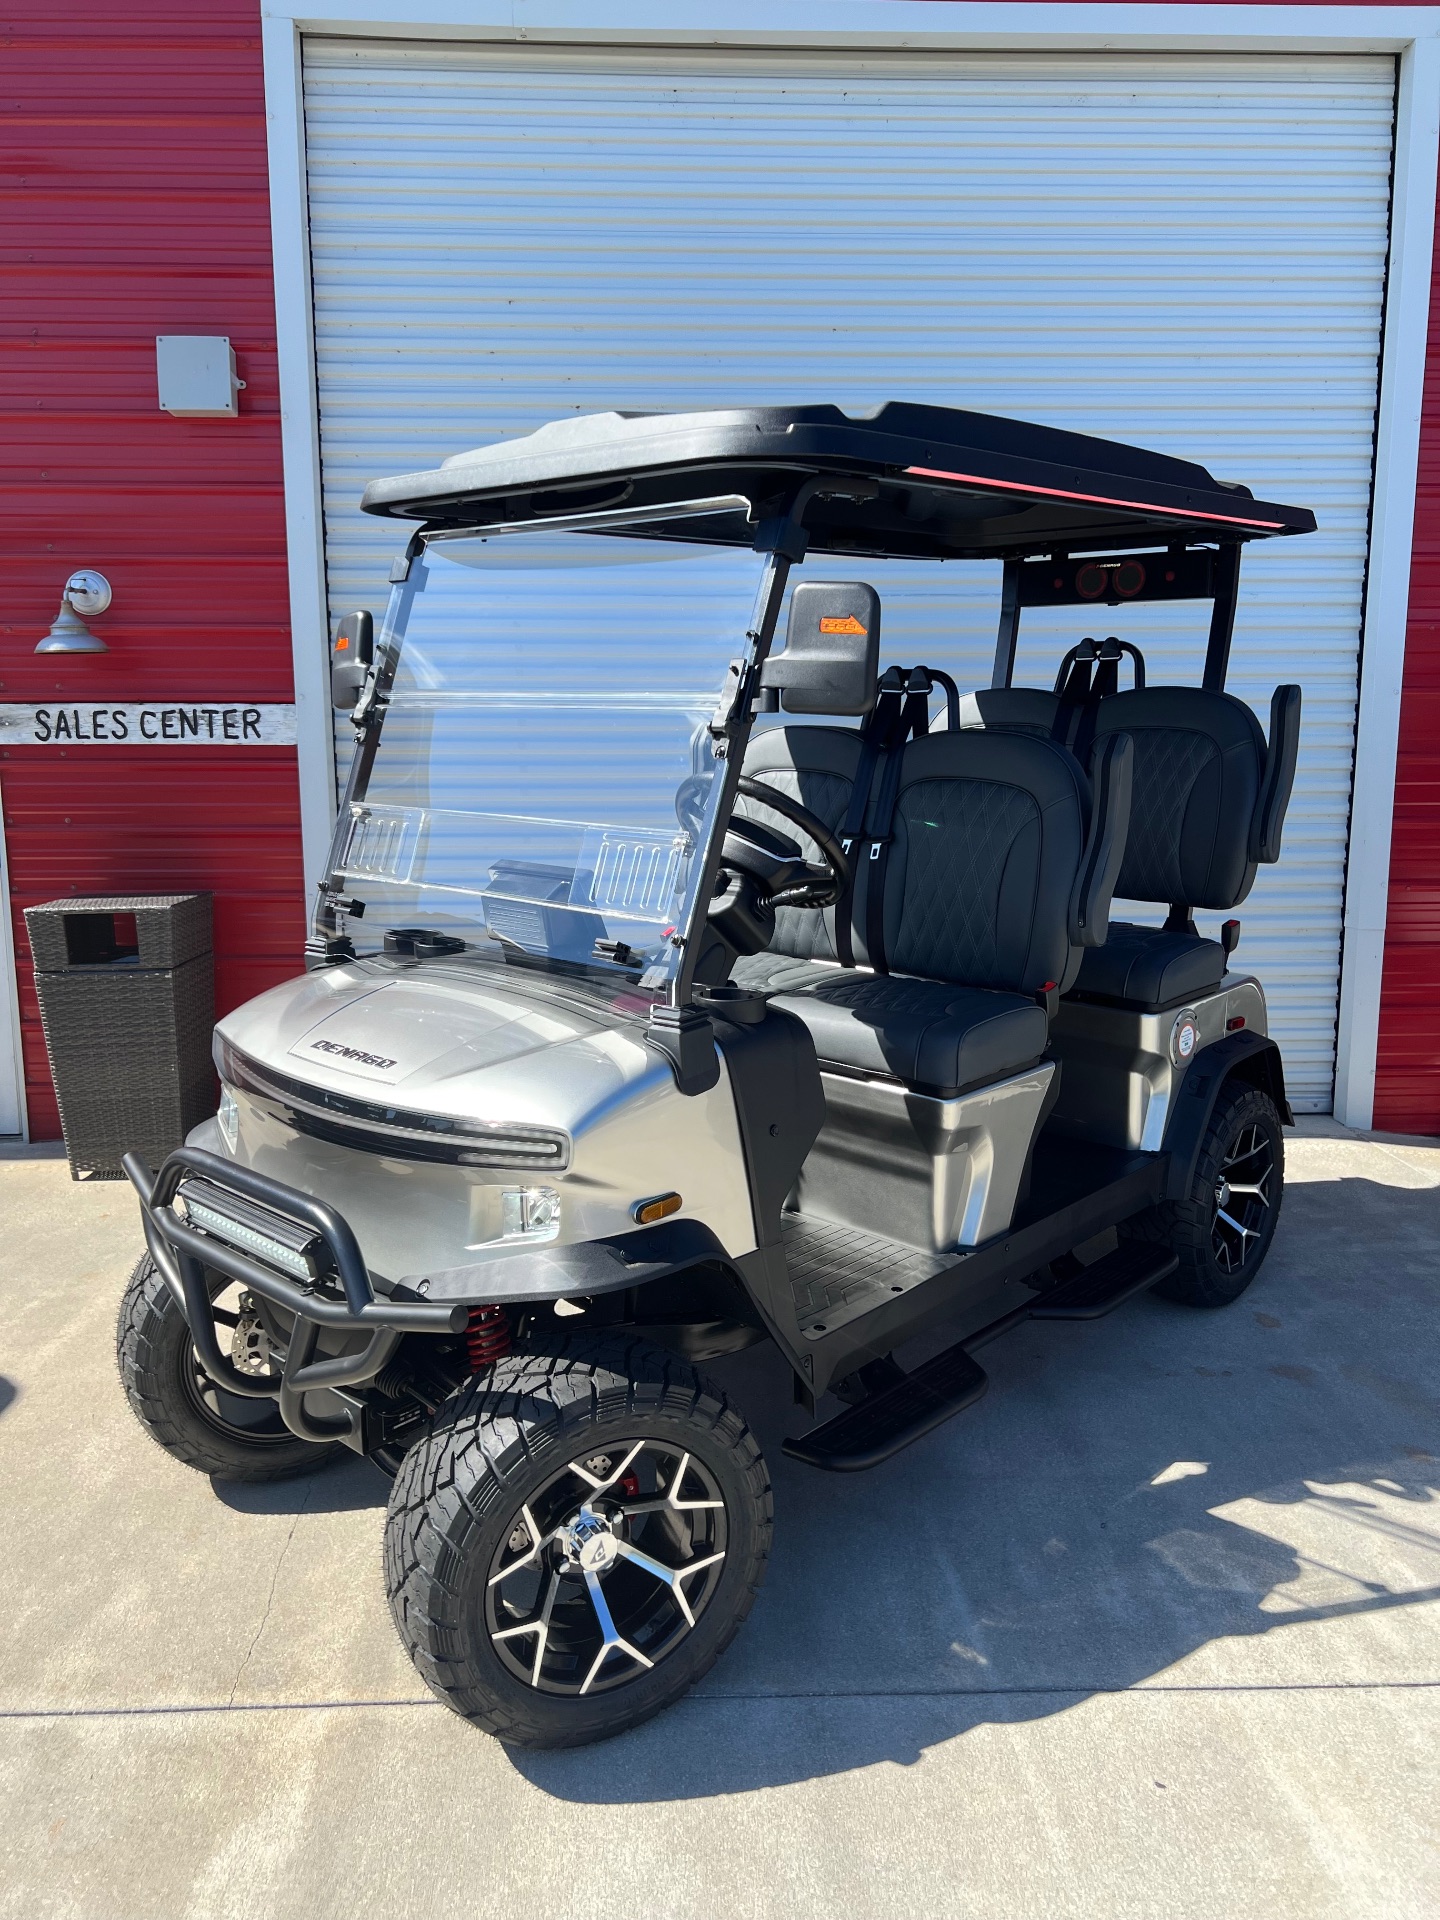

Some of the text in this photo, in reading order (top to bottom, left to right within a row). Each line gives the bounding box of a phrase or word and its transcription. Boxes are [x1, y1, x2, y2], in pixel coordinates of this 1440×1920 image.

[34, 708, 262, 741] SALES CENTER
[310, 1039, 398, 1070] DENAGO
